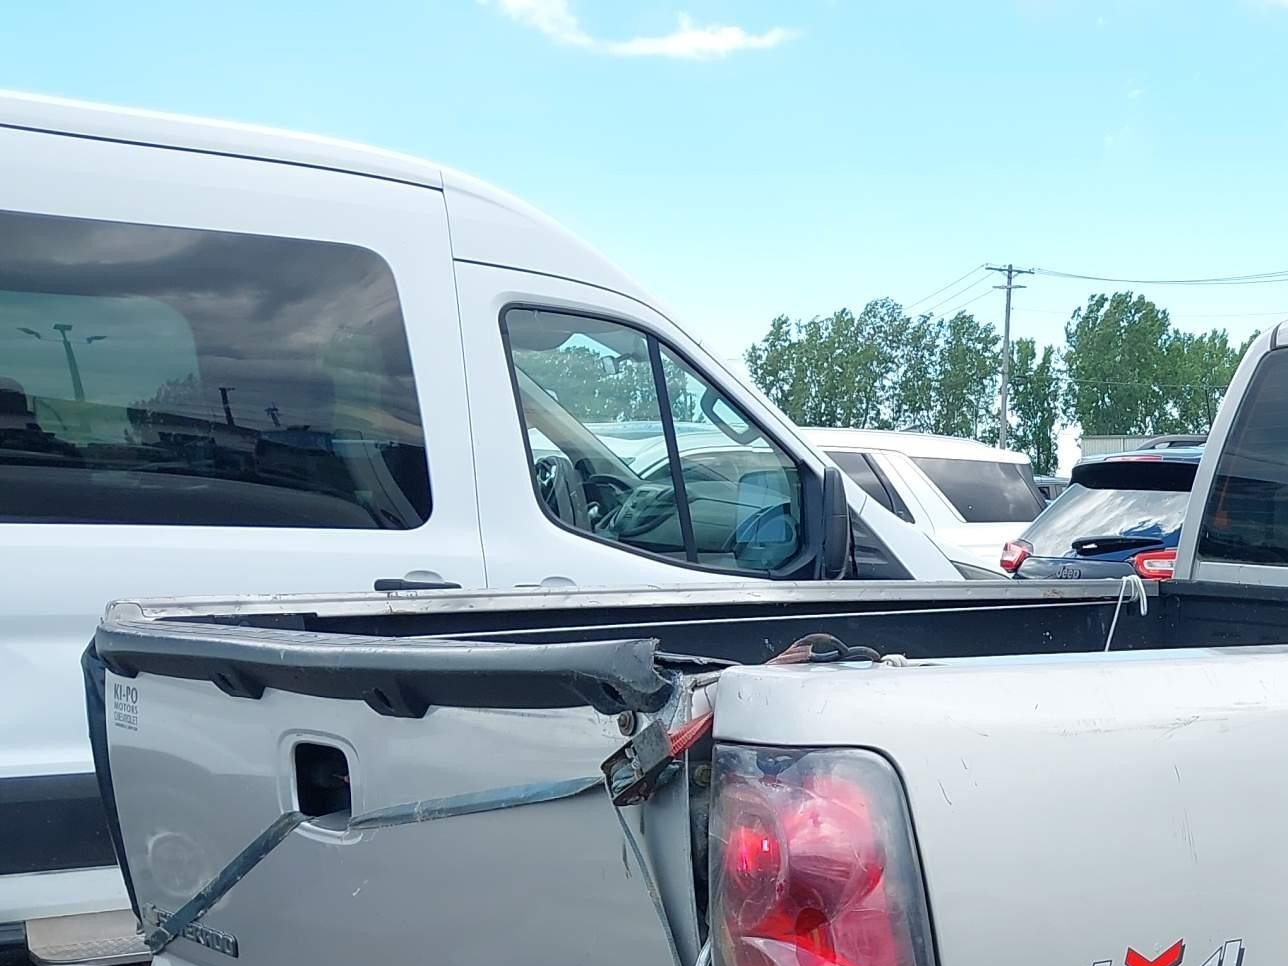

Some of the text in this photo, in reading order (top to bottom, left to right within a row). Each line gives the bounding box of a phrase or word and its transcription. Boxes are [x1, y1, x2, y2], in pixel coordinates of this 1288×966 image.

[1055, 566, 1082, 579] Jeep
[113, 682, 138, 704] KI-PO
[113, 701, 138, 715] MOTORS
